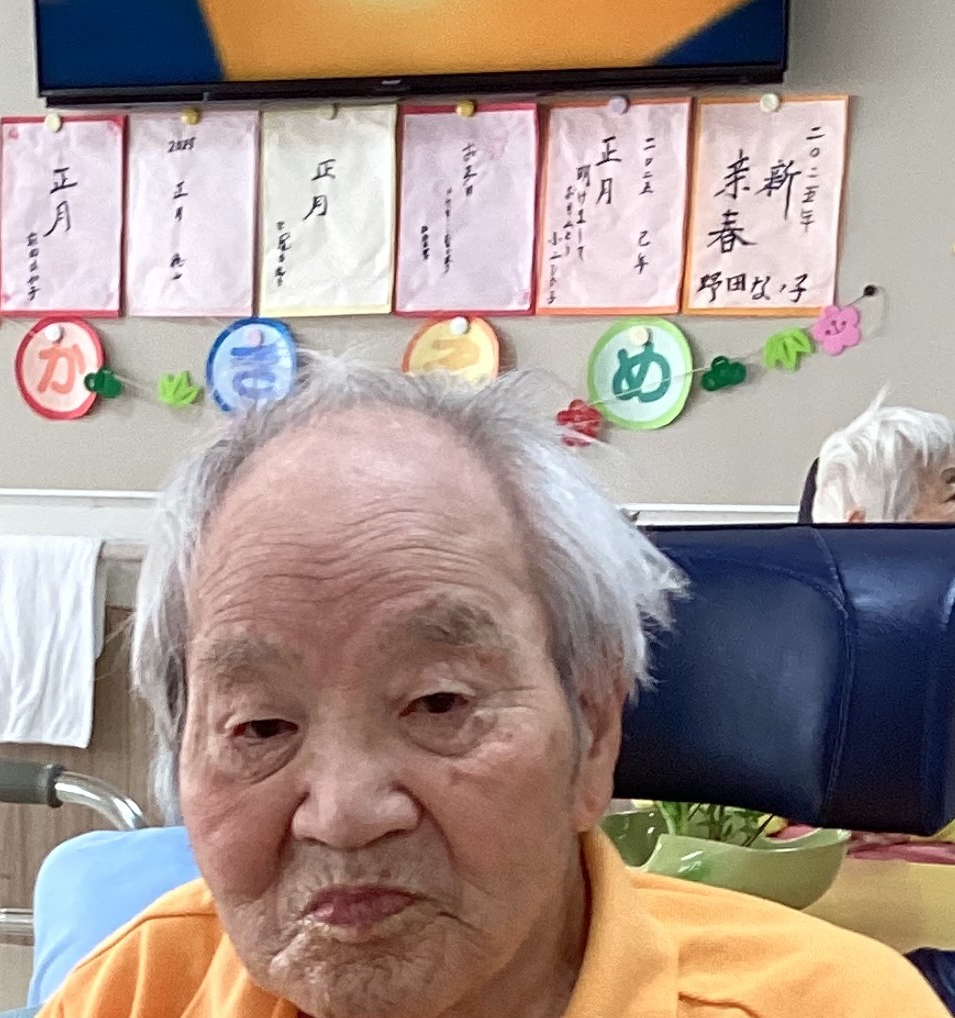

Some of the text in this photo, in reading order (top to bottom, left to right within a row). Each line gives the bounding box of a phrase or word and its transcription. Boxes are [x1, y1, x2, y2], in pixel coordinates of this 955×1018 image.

[43, 166, 79, 238] 正月
[302, 158, 337, 221] 正月
[595, 135, 623, 205] 正月
[37, 343, 86, 394] か
[611, 337, 672, 403] め
